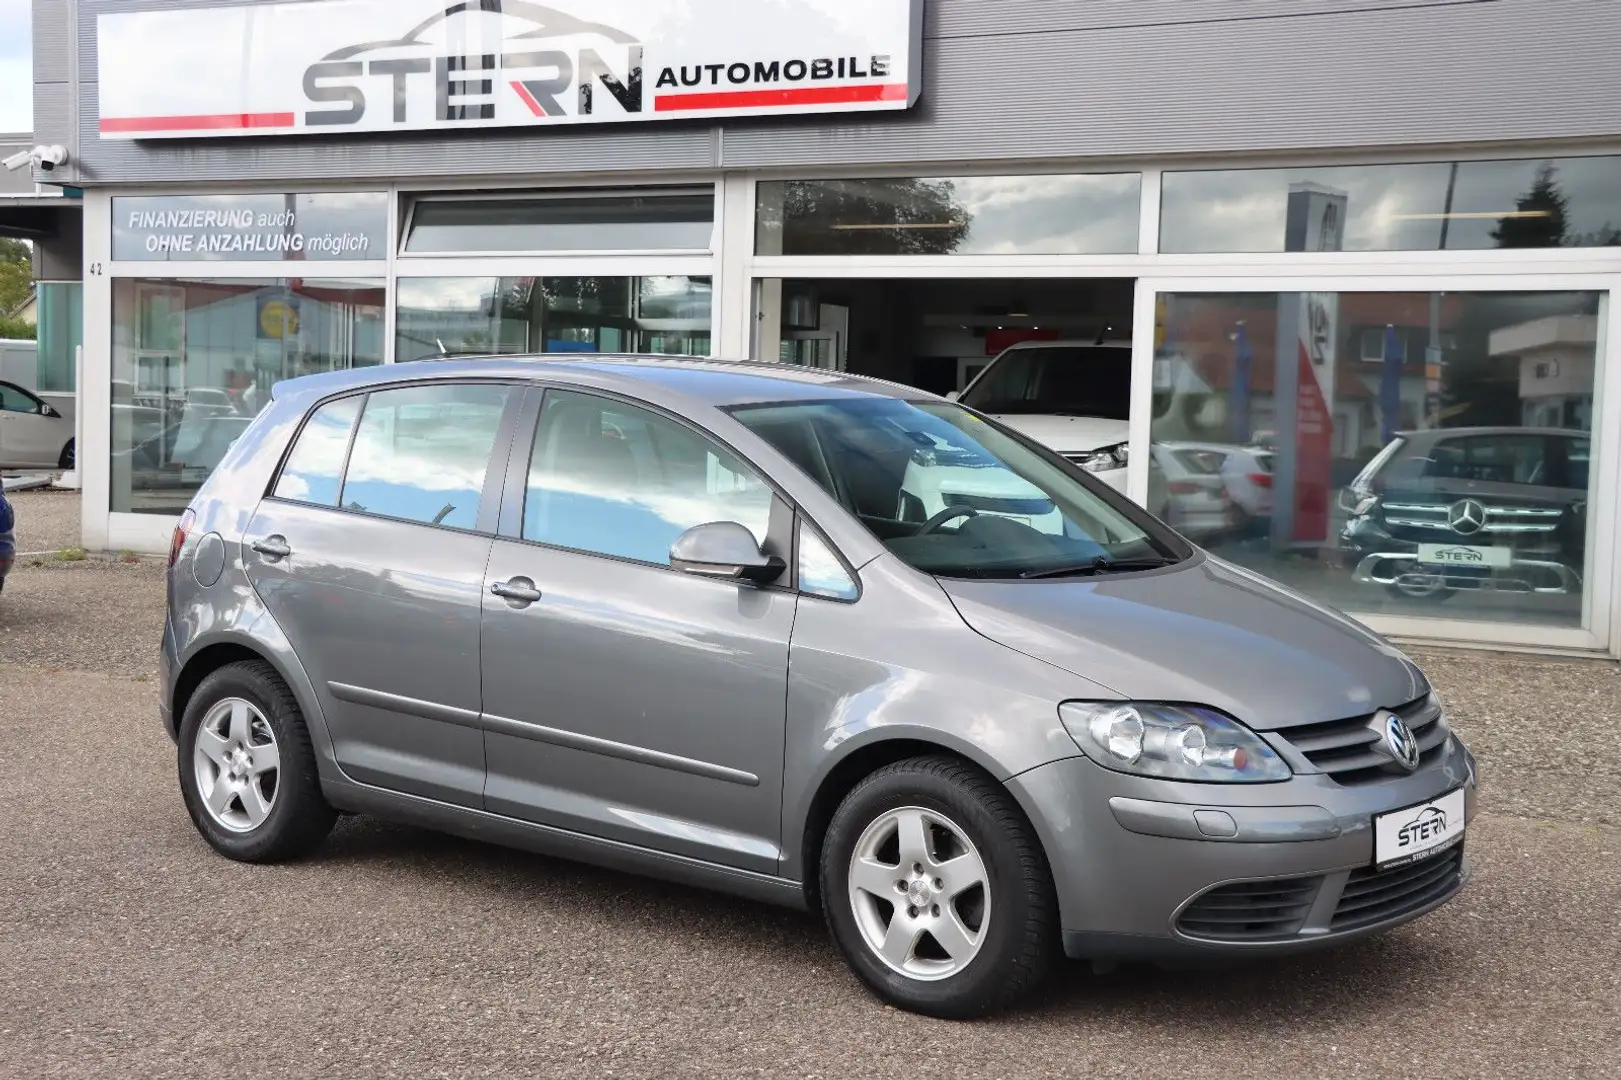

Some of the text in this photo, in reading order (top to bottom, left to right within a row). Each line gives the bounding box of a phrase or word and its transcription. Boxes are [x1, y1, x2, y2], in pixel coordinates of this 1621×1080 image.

[655, 55, 891, 88] AUTOMOBILE
[302, 45, 643, 126] STERN
[128, 208, 296, 229] FINANZIERUNG auch
[145, 231, 369, 256] OHNE ANZAHLUNG möglich
[90, 262, 102, 276] 42
[1434, 551, 1483, 561] STERN
[1398, 815, 1446, 847] STERN
